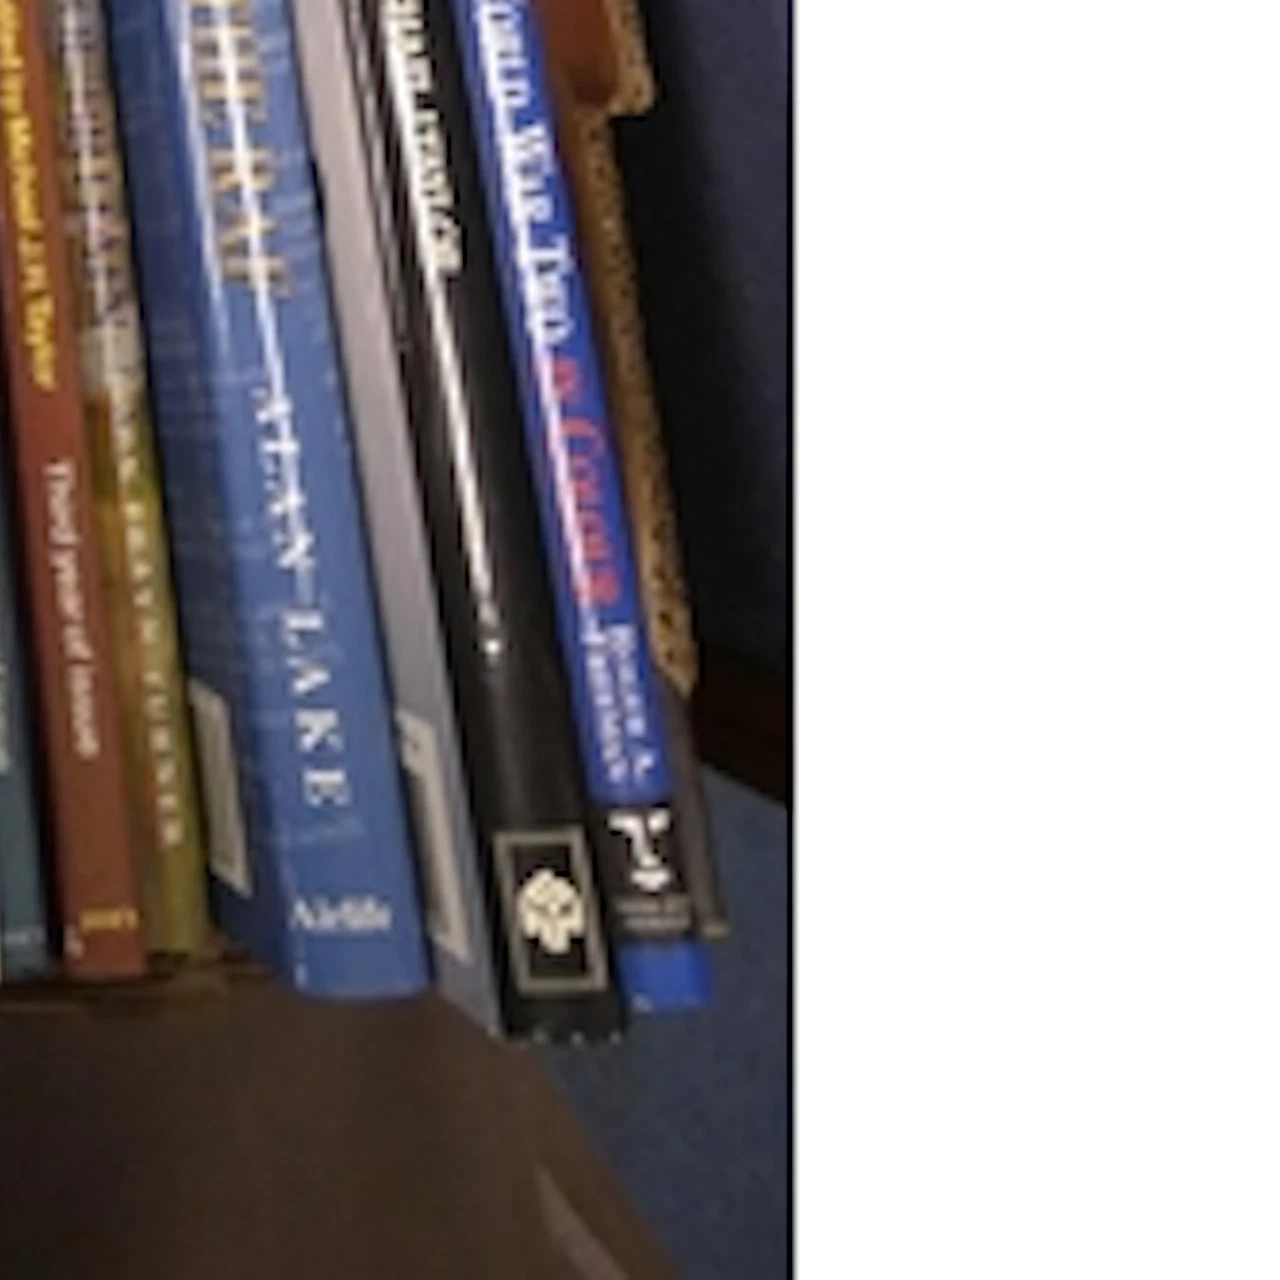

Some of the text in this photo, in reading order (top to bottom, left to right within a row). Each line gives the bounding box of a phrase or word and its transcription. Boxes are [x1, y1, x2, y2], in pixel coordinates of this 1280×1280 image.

[0, 111, 41, 229] Michael
[200, 142, 294, 304] RAF
[489, 116, 564, 228] WAR
[17, 295, 59, 392] Taylor
[509, 237, 585, 347] TWO
[40, 457, 79, 531] Third
[46, 536, 86, 613] year
[245, 382, 353, 816] ALAN LAKE
[62, 660, 102, 759] issue
